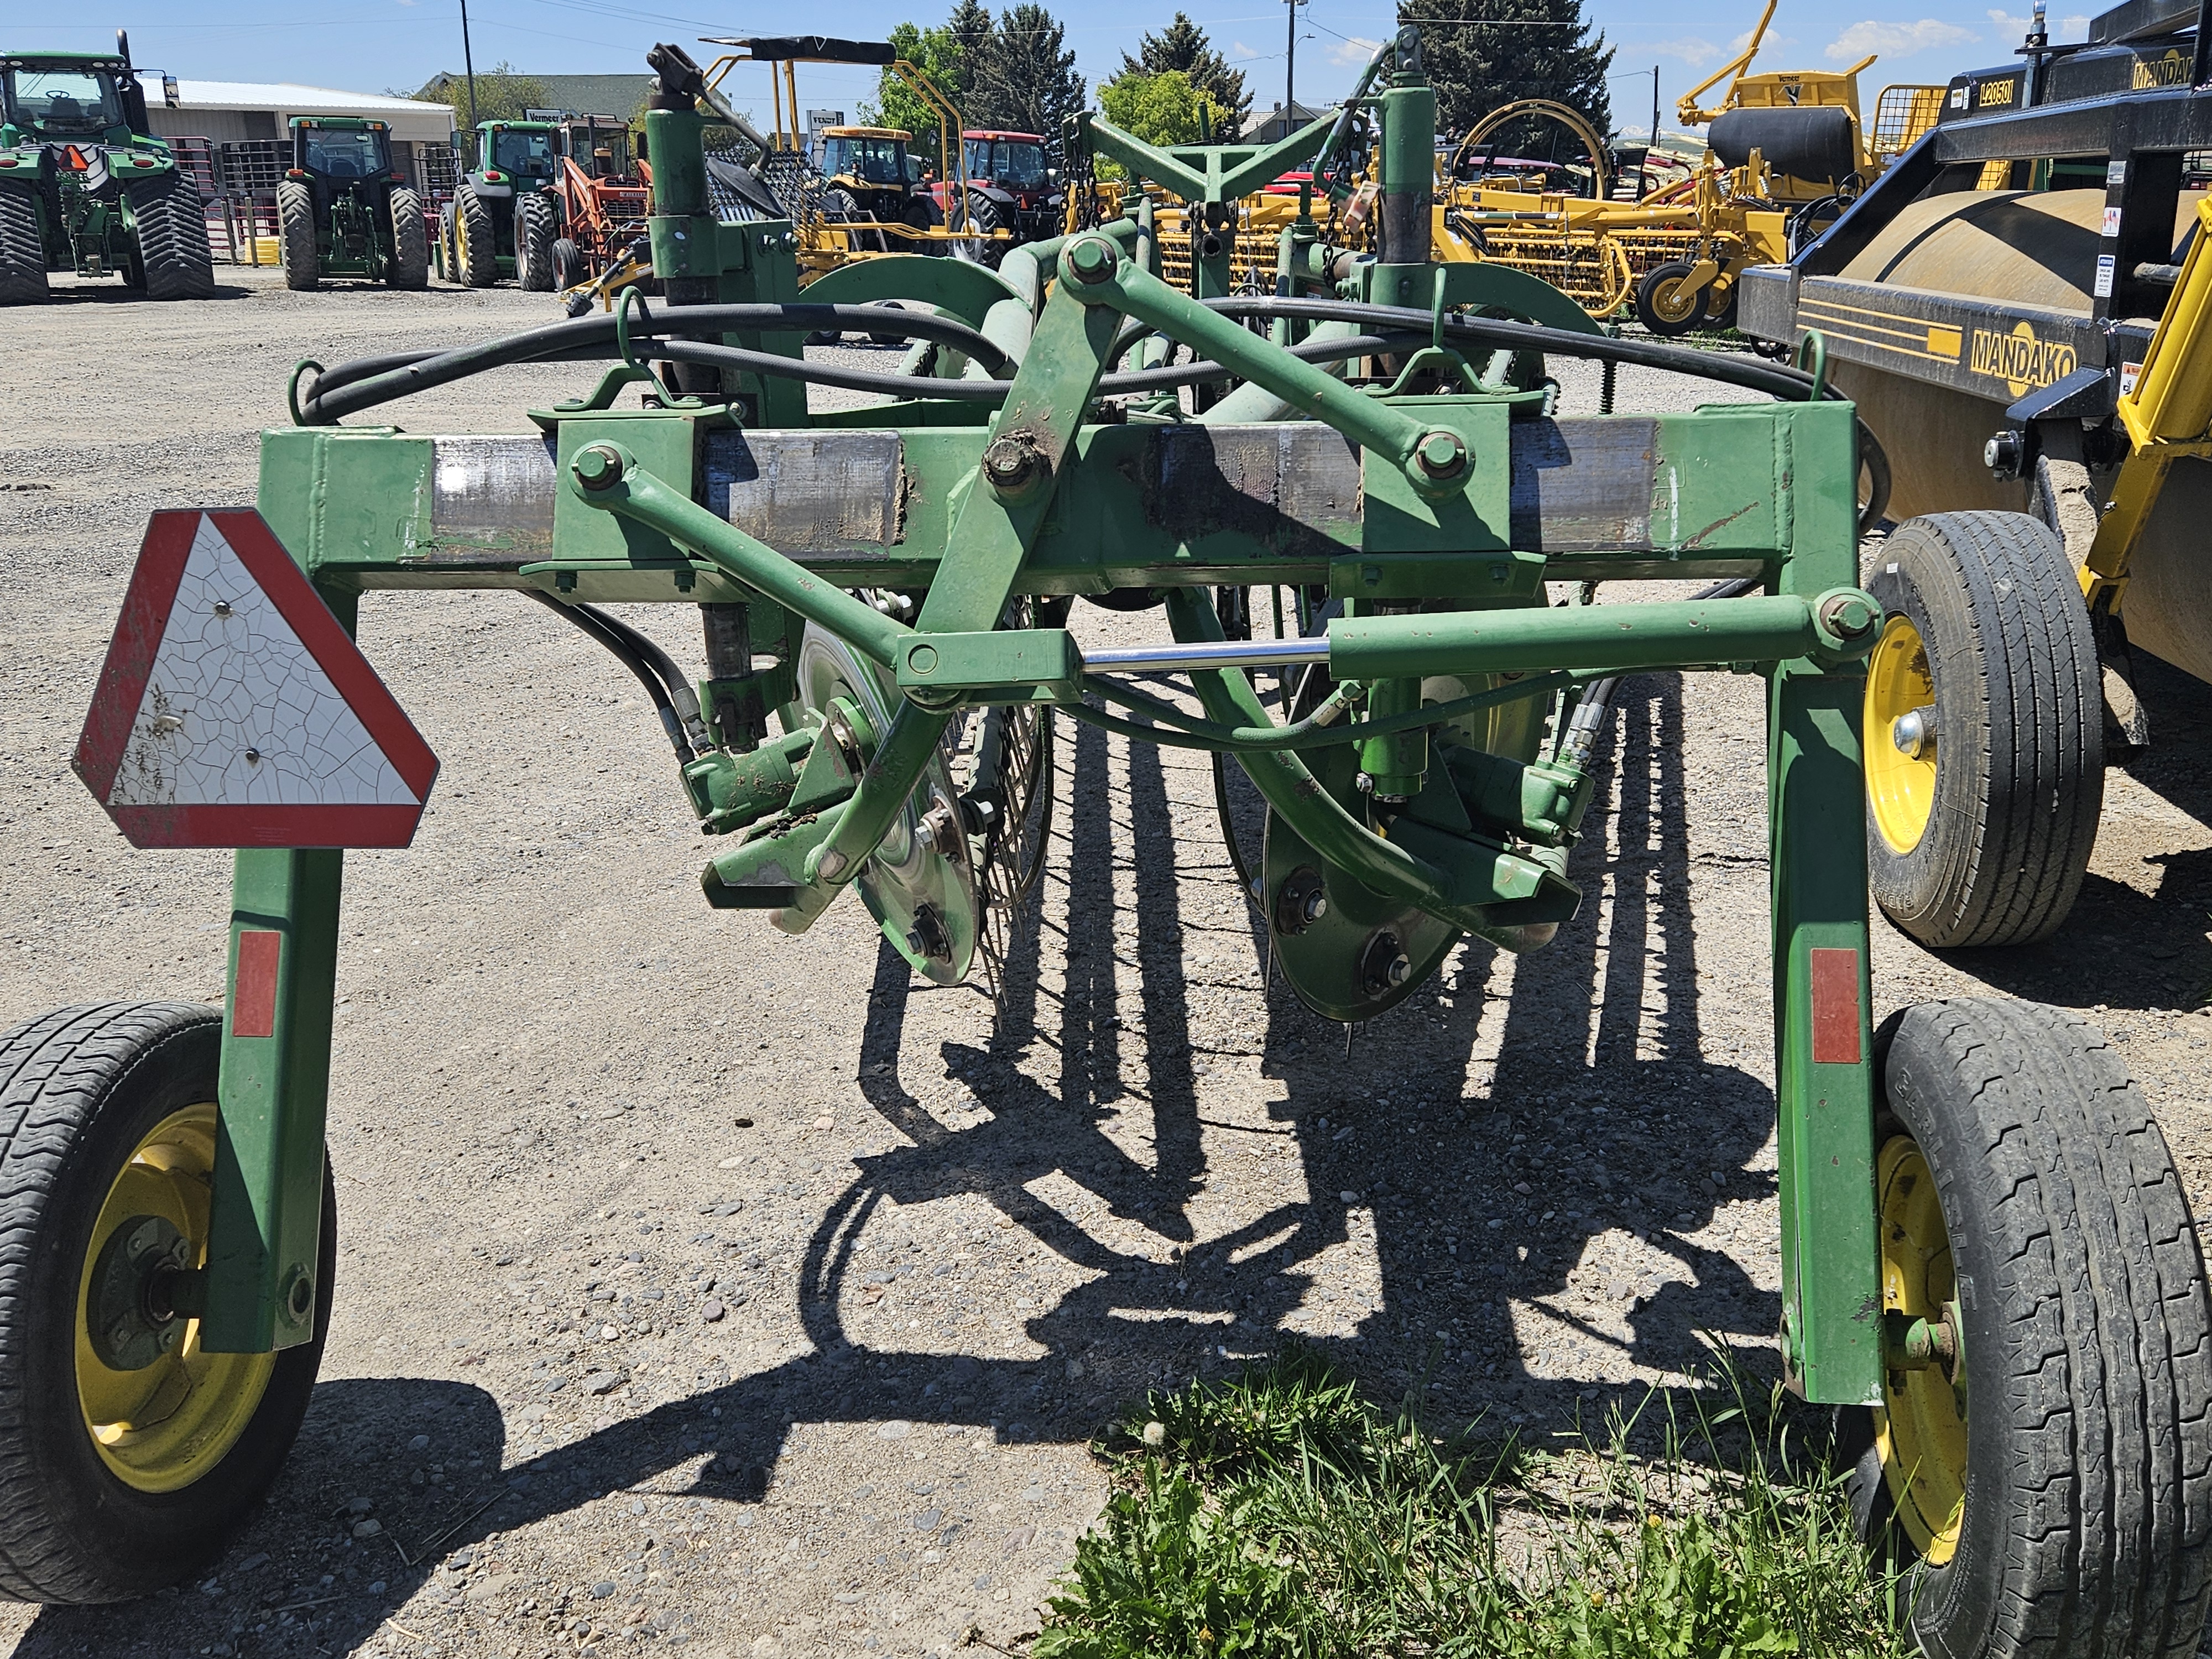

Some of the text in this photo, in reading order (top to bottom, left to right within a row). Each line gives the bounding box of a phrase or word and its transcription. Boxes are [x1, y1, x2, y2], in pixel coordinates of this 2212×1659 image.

[2133, 56, 2194, 89] MANDAK
[529, 112, 559, 122] Vermeer
[1970, 329, 2077, 388] MANDAKO
